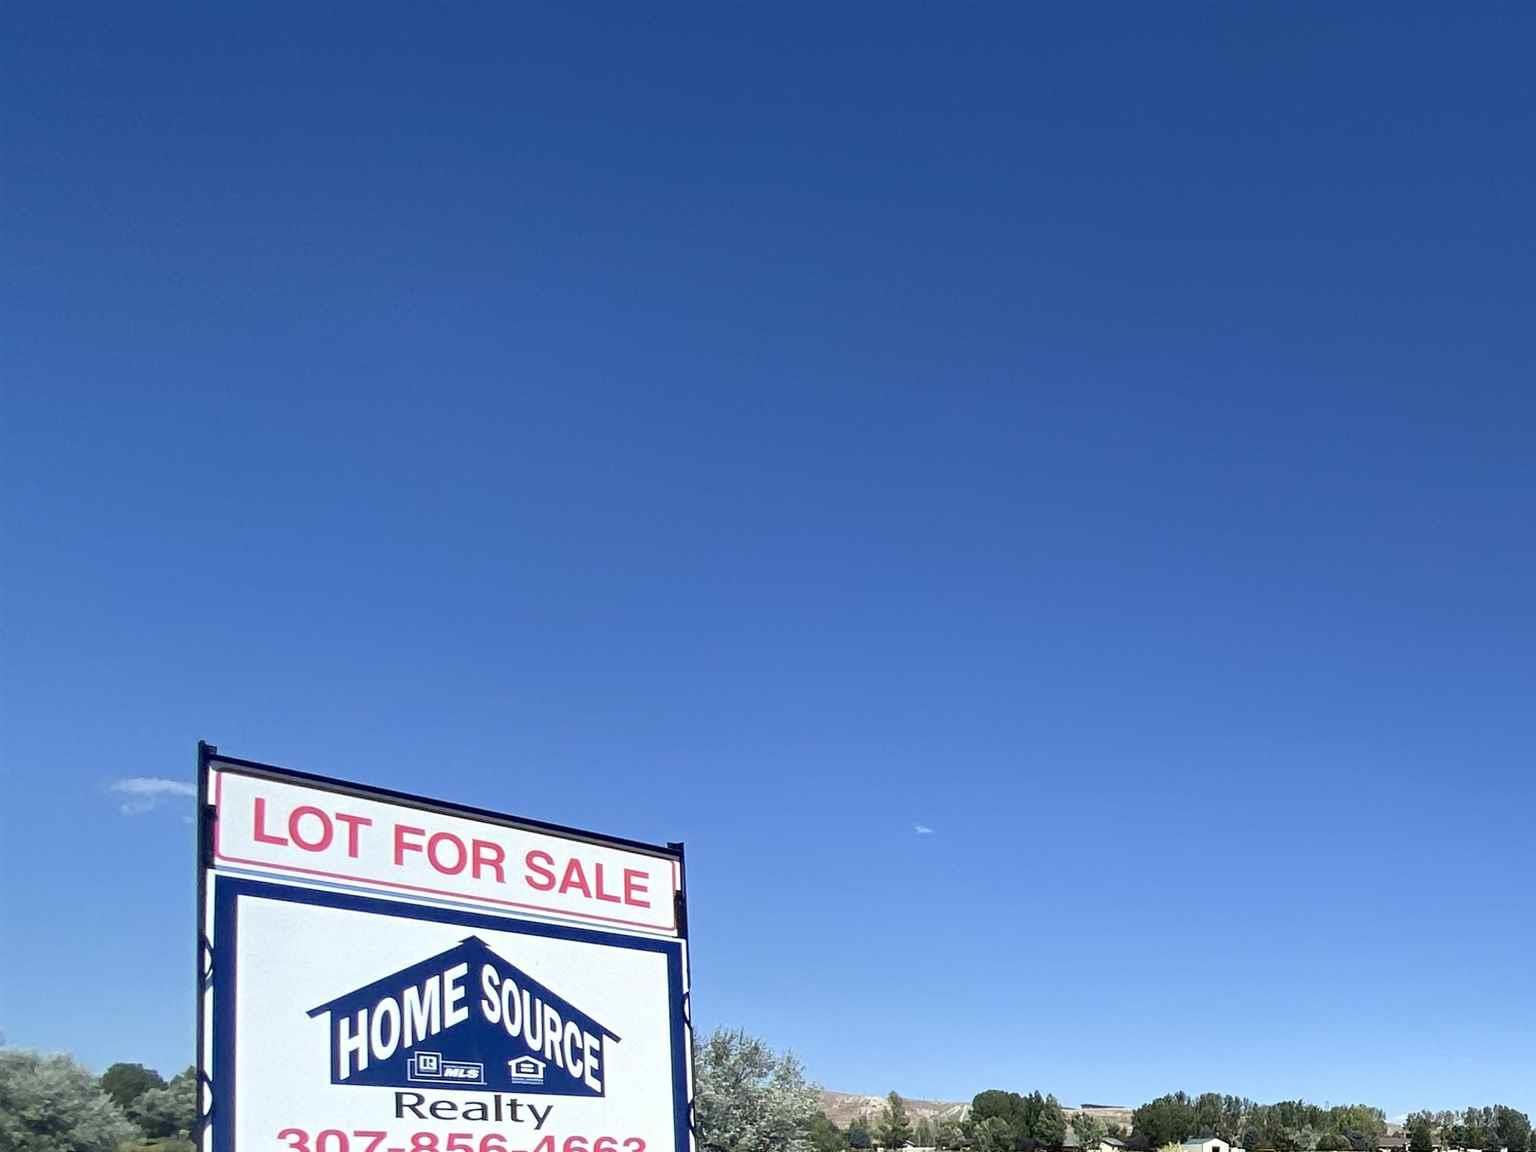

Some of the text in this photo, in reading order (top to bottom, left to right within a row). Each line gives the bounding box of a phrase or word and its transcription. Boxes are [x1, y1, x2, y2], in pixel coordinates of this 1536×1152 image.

[254, 797, 651, 909] LOT FOR SALE
[339, 961, 602, 1094] HOME SOURCE
[394, 1091, 553, 1130] Realty
[443, 1067, 480, 1079] MLS
